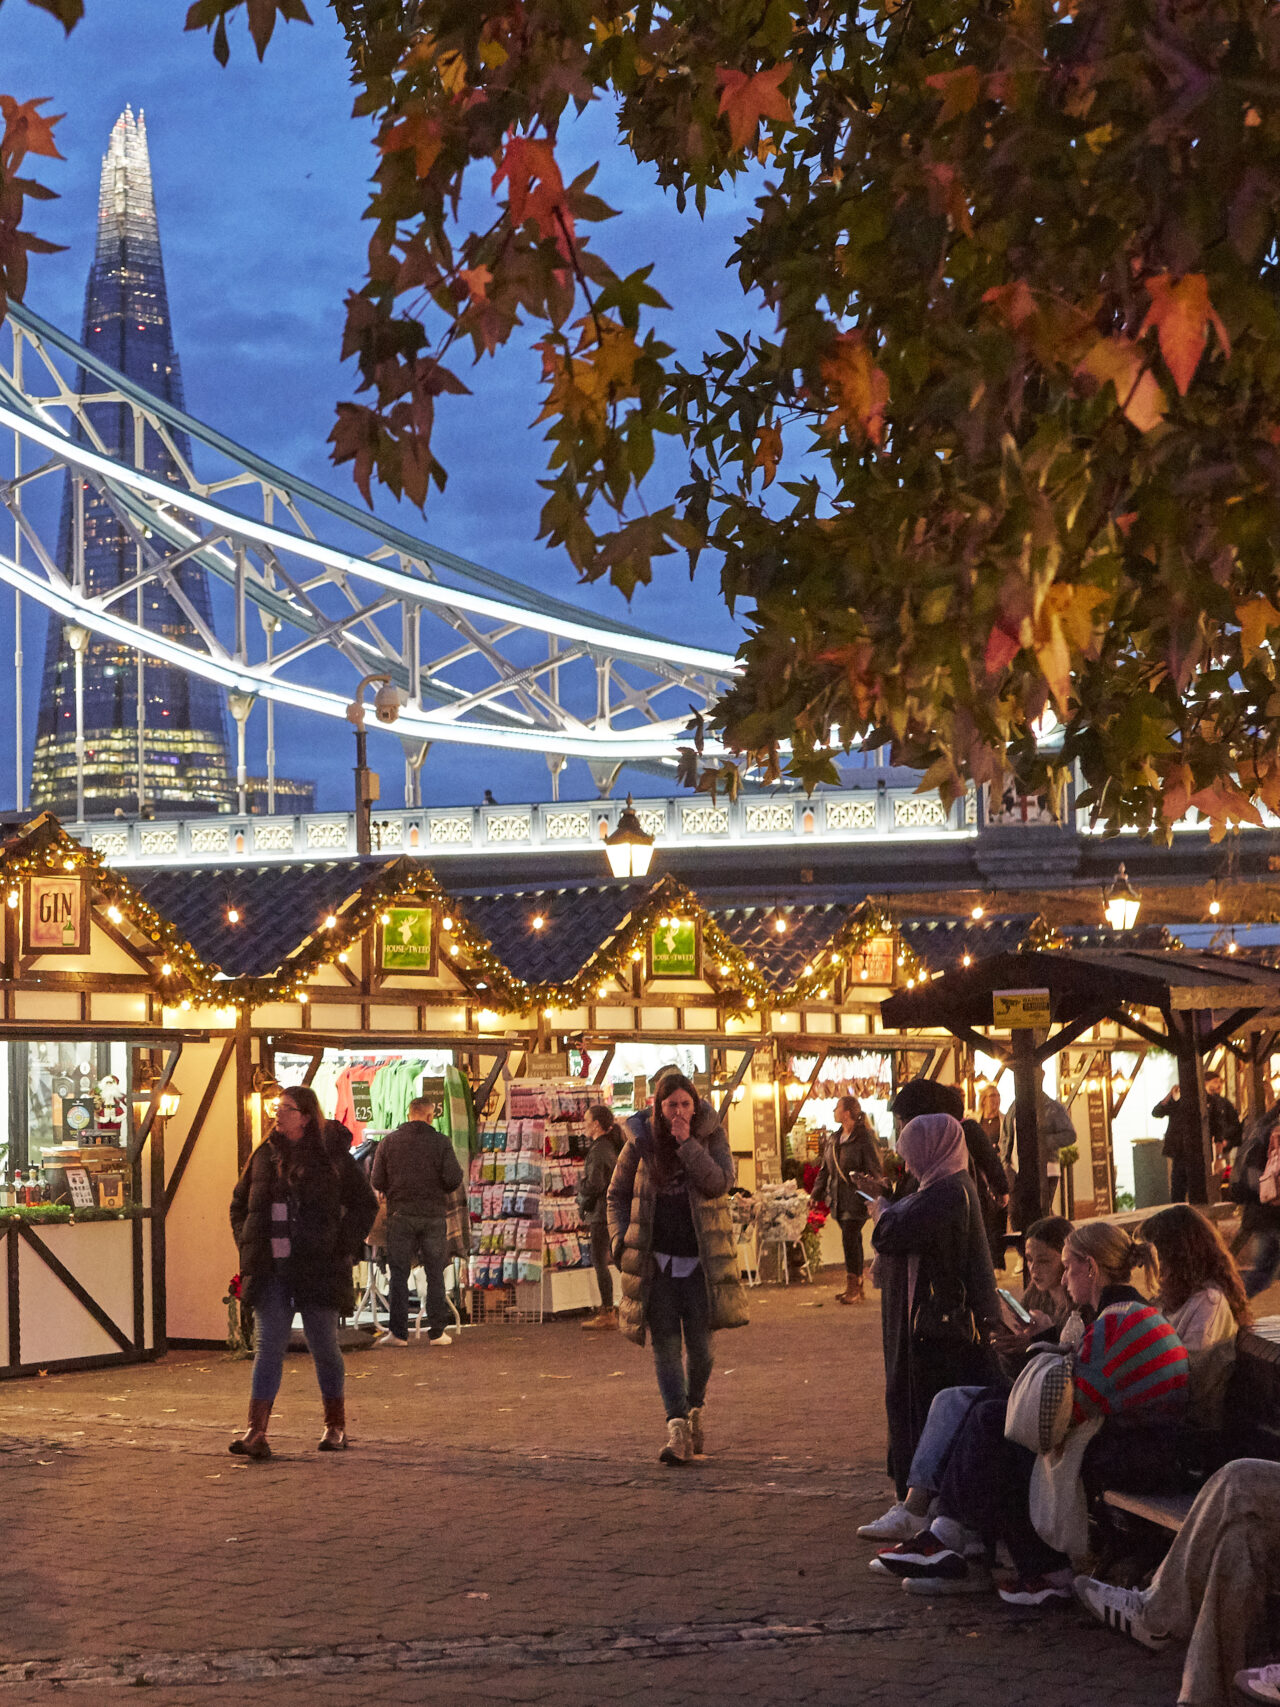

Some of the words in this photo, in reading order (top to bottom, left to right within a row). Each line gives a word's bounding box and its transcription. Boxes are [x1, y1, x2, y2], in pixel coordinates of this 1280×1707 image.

[40, 891, 72, 923] GIN
[384, 945, 404, 953] HOUSE
[409, 945, 430, 954] TWEED
[355, 1106, 373, 1120] £25
